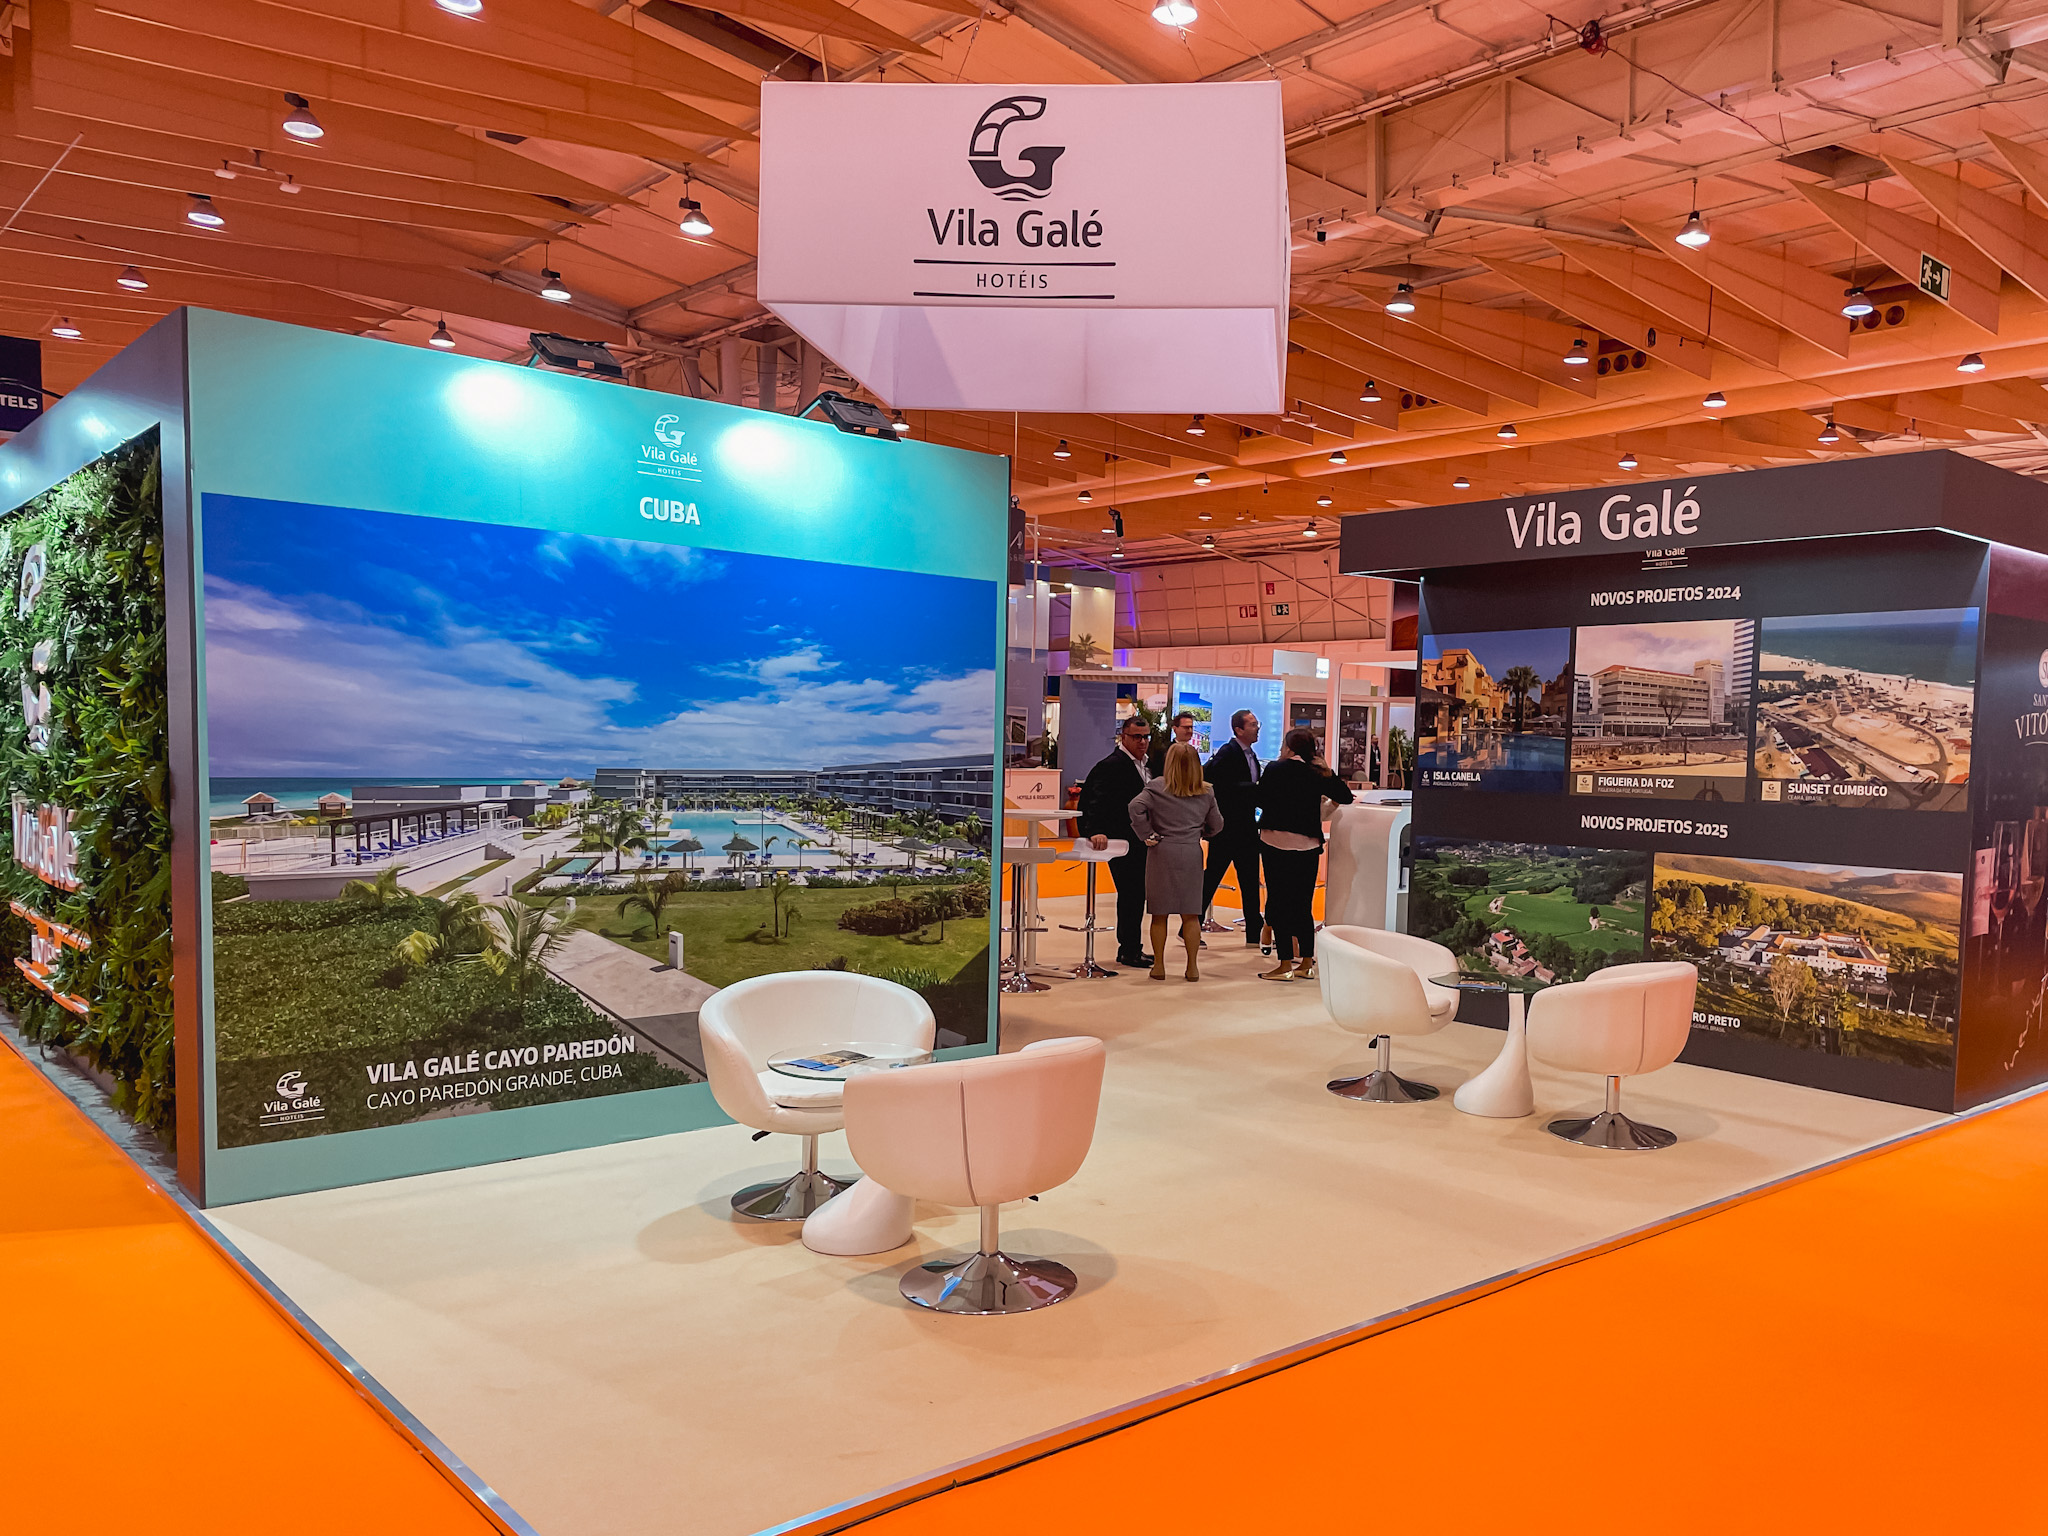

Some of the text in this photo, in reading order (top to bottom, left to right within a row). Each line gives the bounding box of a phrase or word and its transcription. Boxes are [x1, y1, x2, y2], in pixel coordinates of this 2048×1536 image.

[927, 208, 1103, 248] Vila Galé
[976, 270, 1048, 288] HOTÉIS
[0, 394, 39, 410] TELS
[641, 444, 698, 466] Vila Galé
[640, 496, 701, 526] CUBA
[1506, 485, 1701, 549] Vila Galé
[1590, 585, 1741, 607] NOVOS PROJETOS 2024
[1433, 771, 1481, 782] ISLA CANELA
[1598, 777, 1675, 788] FIGUEIRA DA FOZ
[1788, 783, 1831, 795] SUNSET
[1833, 784, 1888, 797] CUMBUCO
[1581, 815, 1728, 839] NOVOS PROJETOS 2025
[1708, 1014, 1741, 1029] PRETO
[366, 1034, 635, 1085] VILA GALÉ CAYO PAREDÓN
[367, 1063, 623, 1110] CAYO PAREDÓN GRANDE, CUBA
[263, 1096, 321, 1113] Vila Galé
